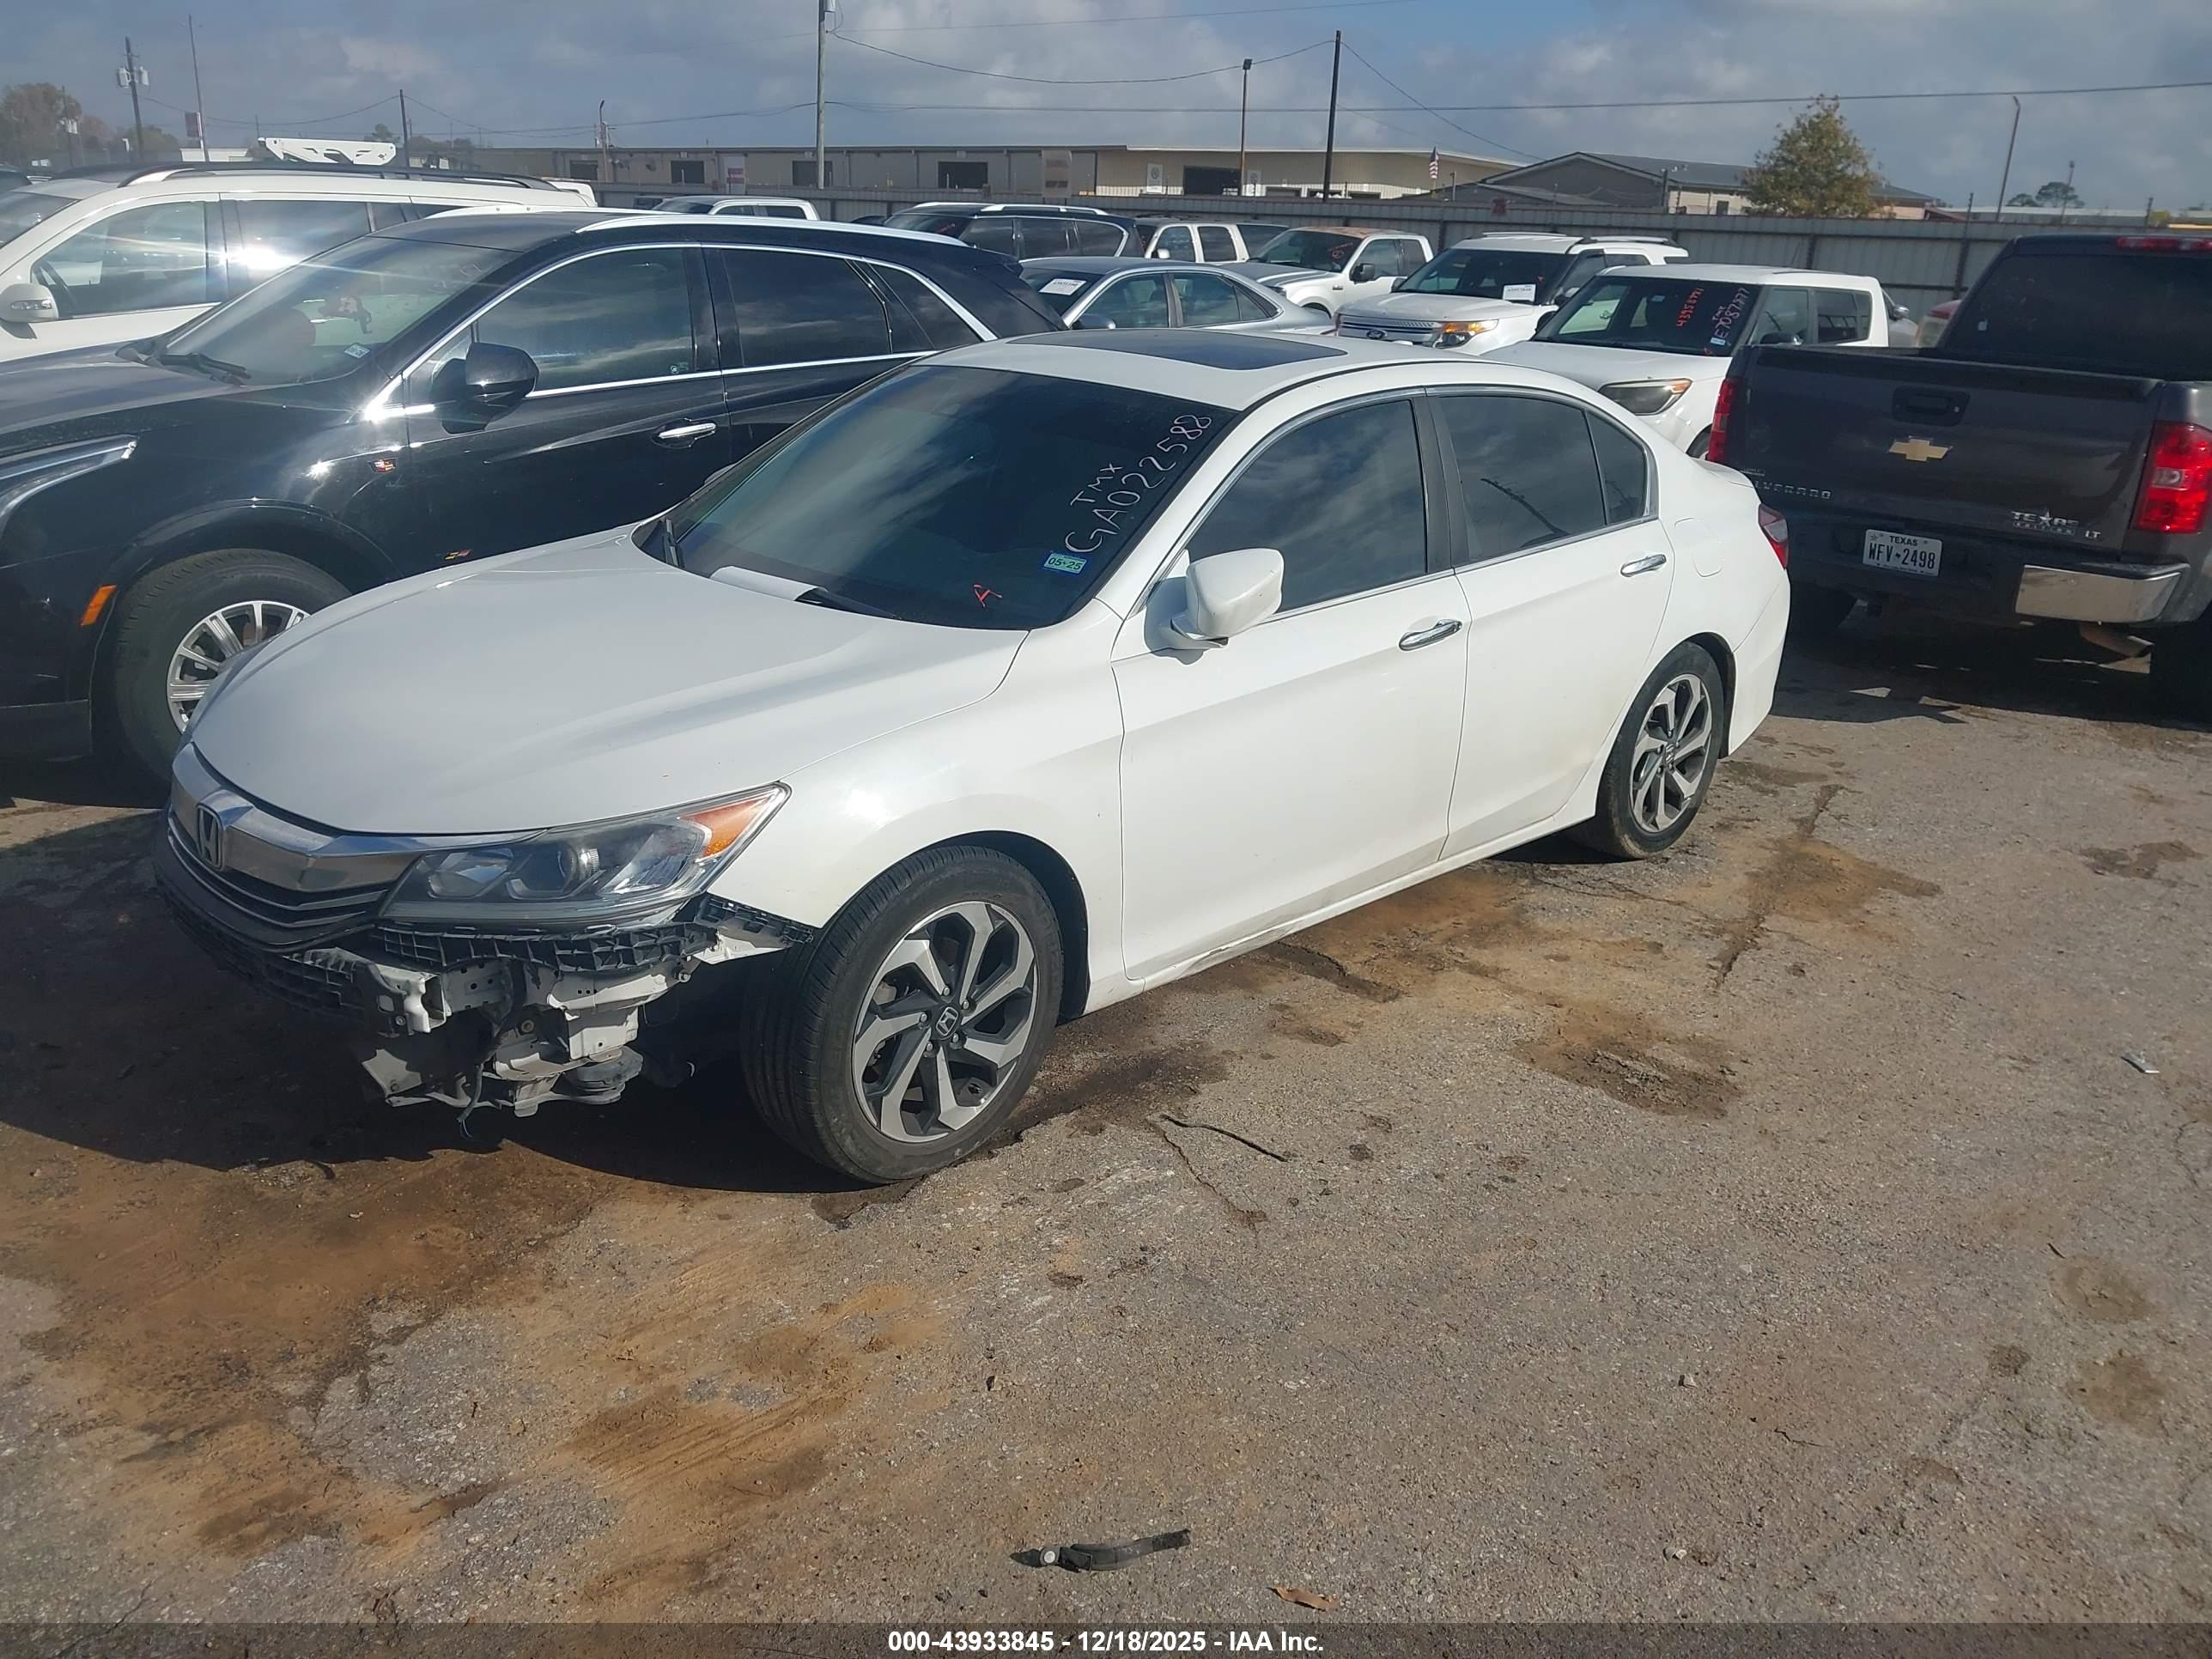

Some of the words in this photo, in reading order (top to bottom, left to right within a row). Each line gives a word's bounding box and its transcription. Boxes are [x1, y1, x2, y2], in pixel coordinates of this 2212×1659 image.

[1065, 414, 1212, 553] GA022588
[1070, 463, 1123, 506] TMX
[1889, 535, 1917, 547] TEXAS
